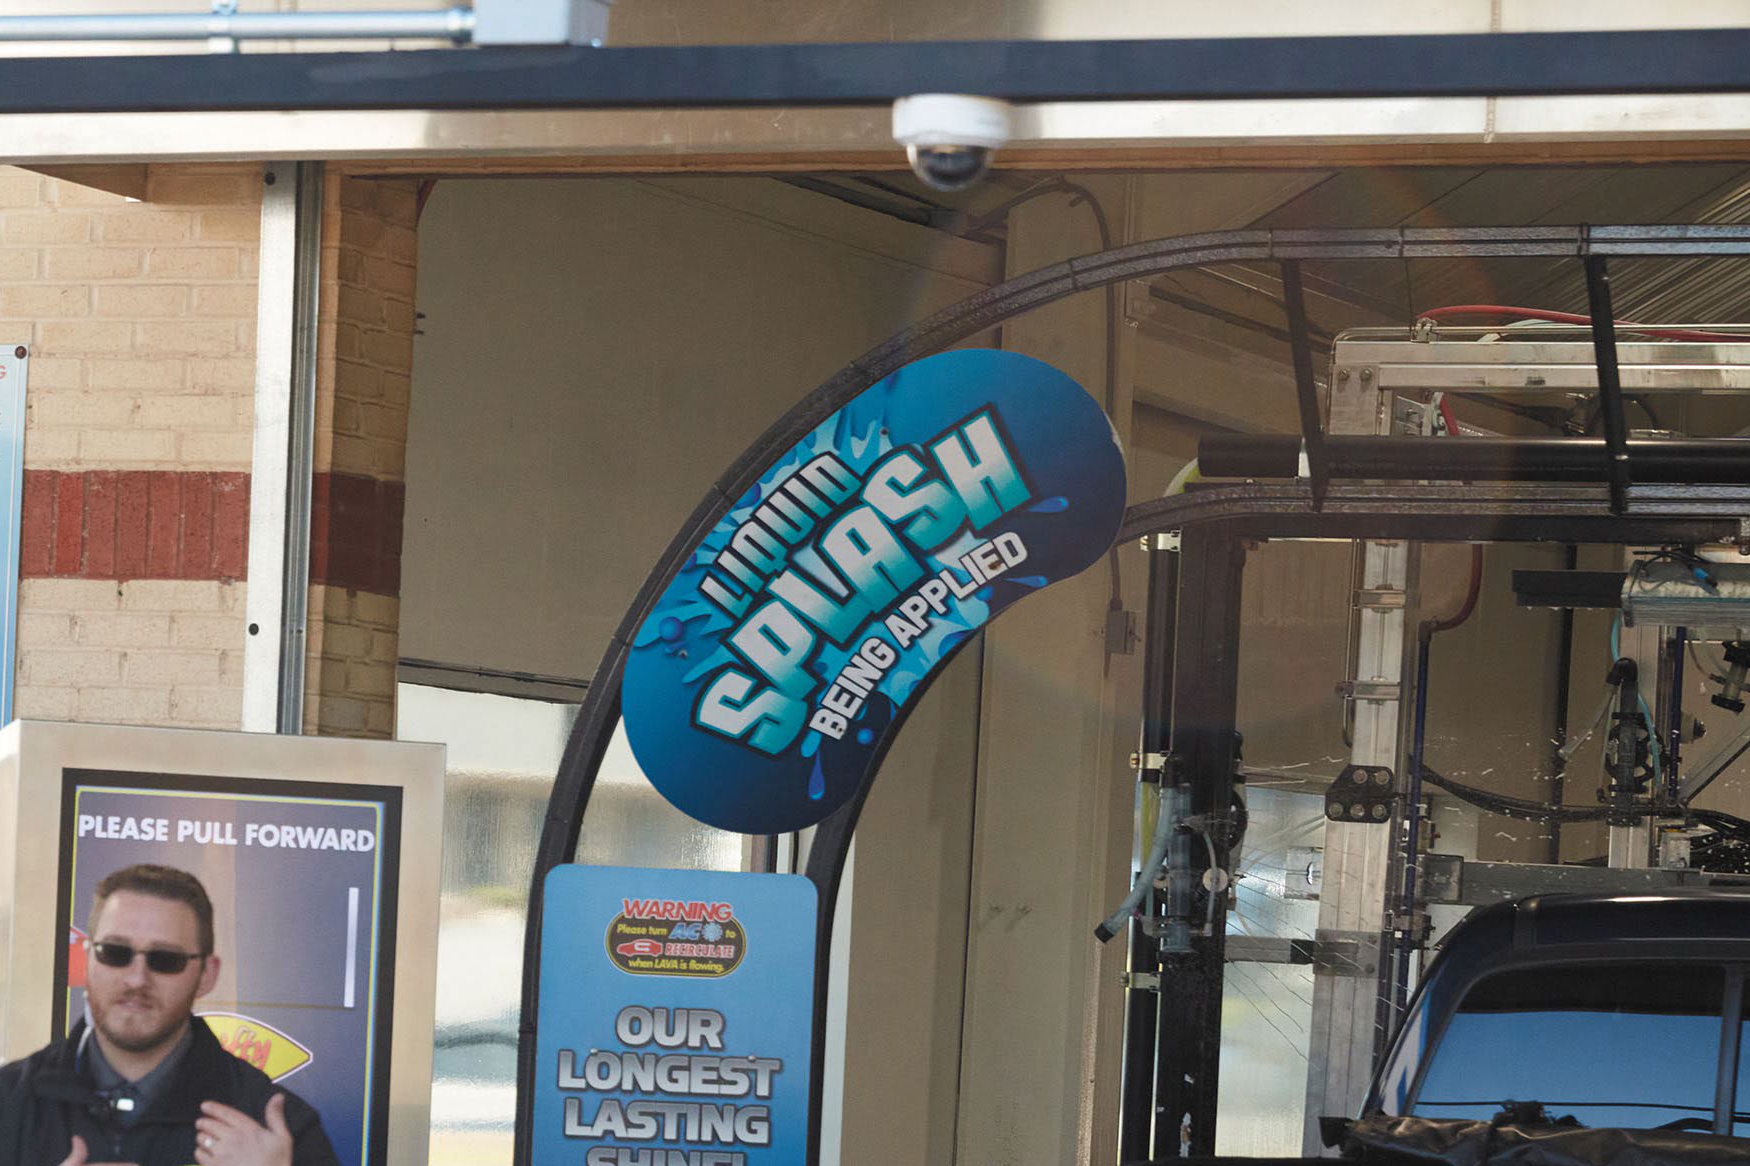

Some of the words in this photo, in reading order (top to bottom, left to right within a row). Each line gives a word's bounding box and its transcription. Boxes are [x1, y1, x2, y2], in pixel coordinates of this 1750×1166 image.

[699, 453, 862, 618] LIQUID
[694, 413, 1034, 757] SPLASH
[808, 636, 896, 740] BEING
[883, 531, 1029, 648] APPLIED
[78, 814, 168, 843] PLEASE
[177, 819, 237, 846] PULL
[244, 822, 376, 853] FORWARD
[617, 924, 647, 934] Please
[649, 926, 667, 935] turn
[668, 922, 702, 940] AC
[725, 930, 736, 938] to
[623, 899, 732, 922] WARNING
[628, 959, 653, 968] when
[654, 959, 678, 969] LAVA
[680, 960, 687, 970] is
[665, 942, 735, 958] RECIRCULATE
[615, 1005, 726, 1049] OUR
[557, 1049, 783, 1098] LONGEST
[563, 1097, 771, 1146] LASTING
